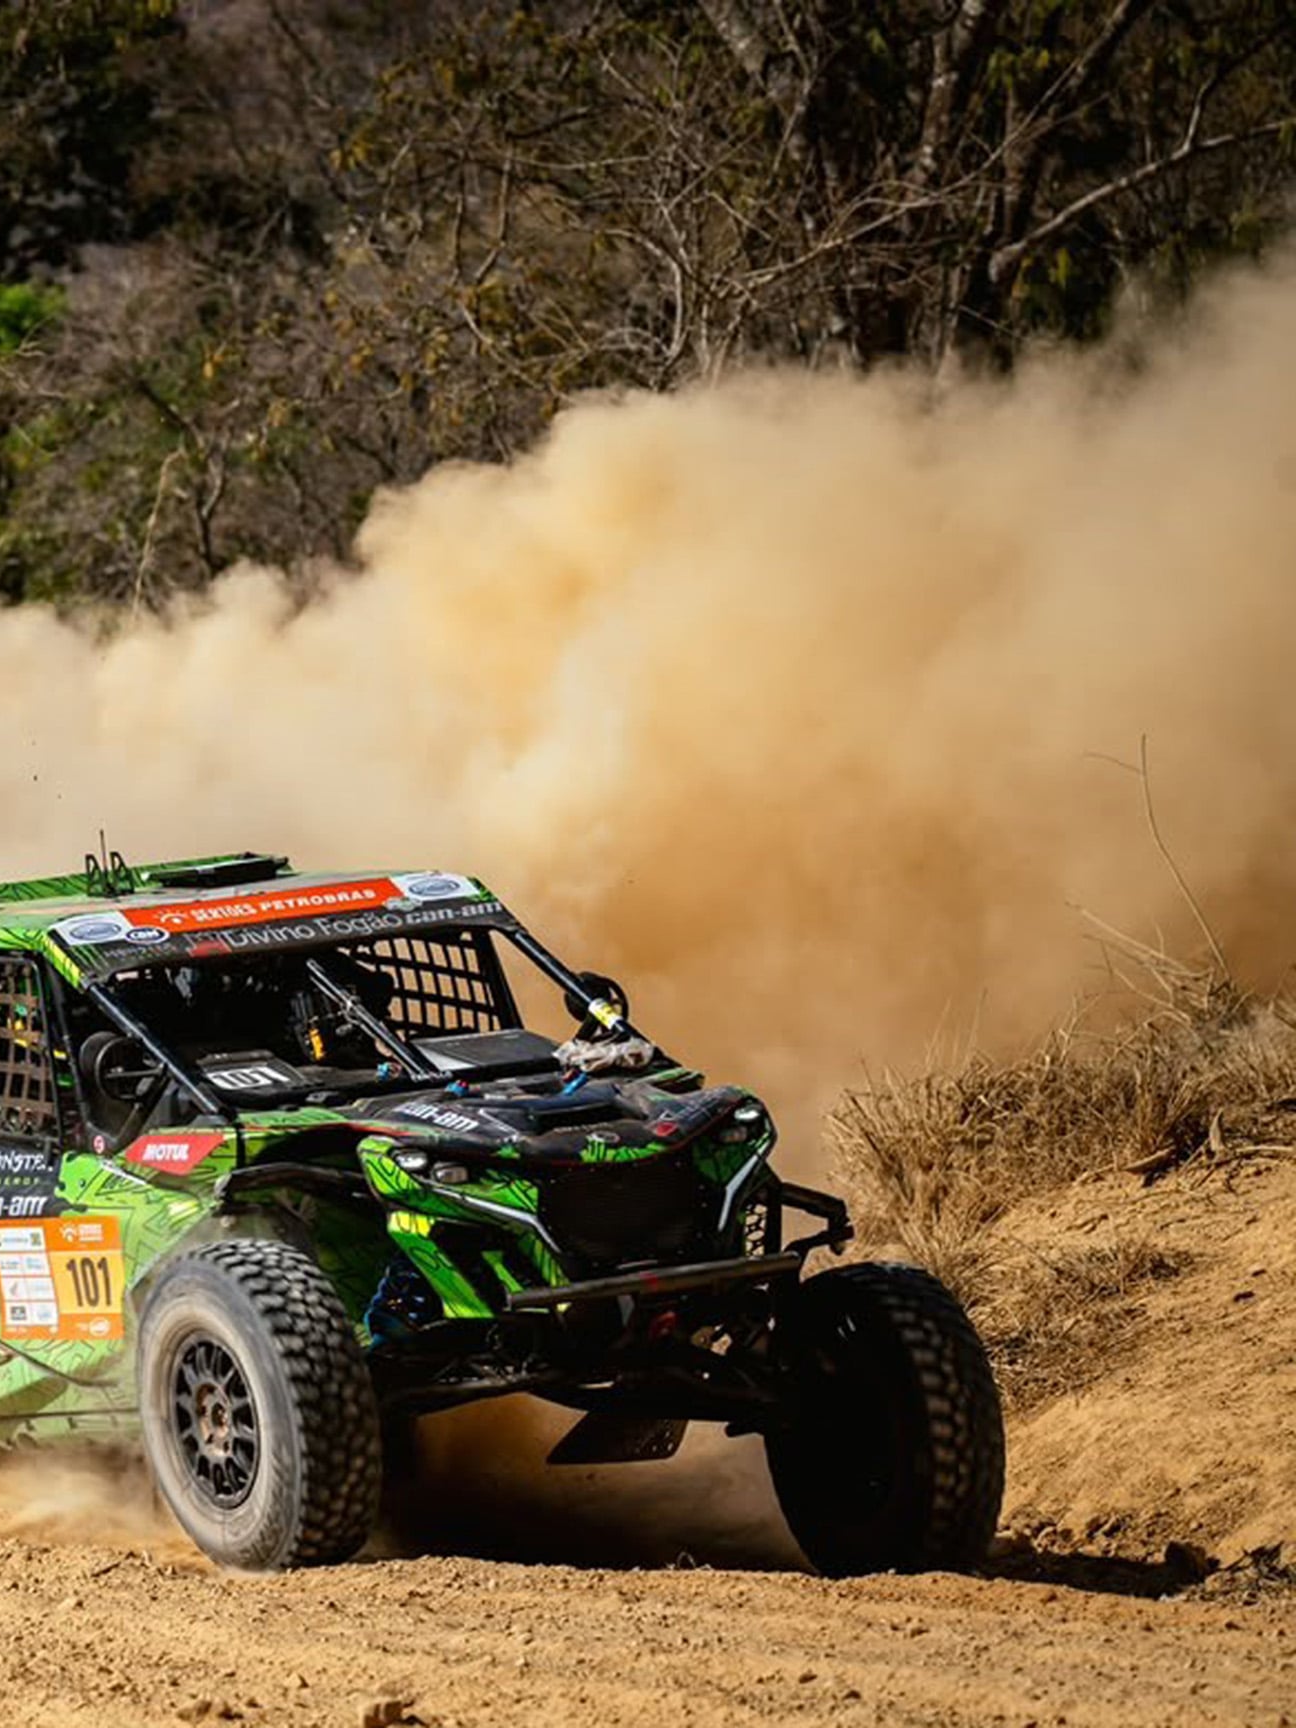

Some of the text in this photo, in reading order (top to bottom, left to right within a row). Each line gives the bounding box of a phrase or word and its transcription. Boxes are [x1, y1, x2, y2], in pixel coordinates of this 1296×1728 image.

[260, 889, 377, 911] PETROBRAS
[406, 902, 502, 925] can-am
[222, 912, 403, 948] Divino Fogão
[142, 1144, 190, 1161] MOTUL
[66, 1256, 112, 1307] 101
